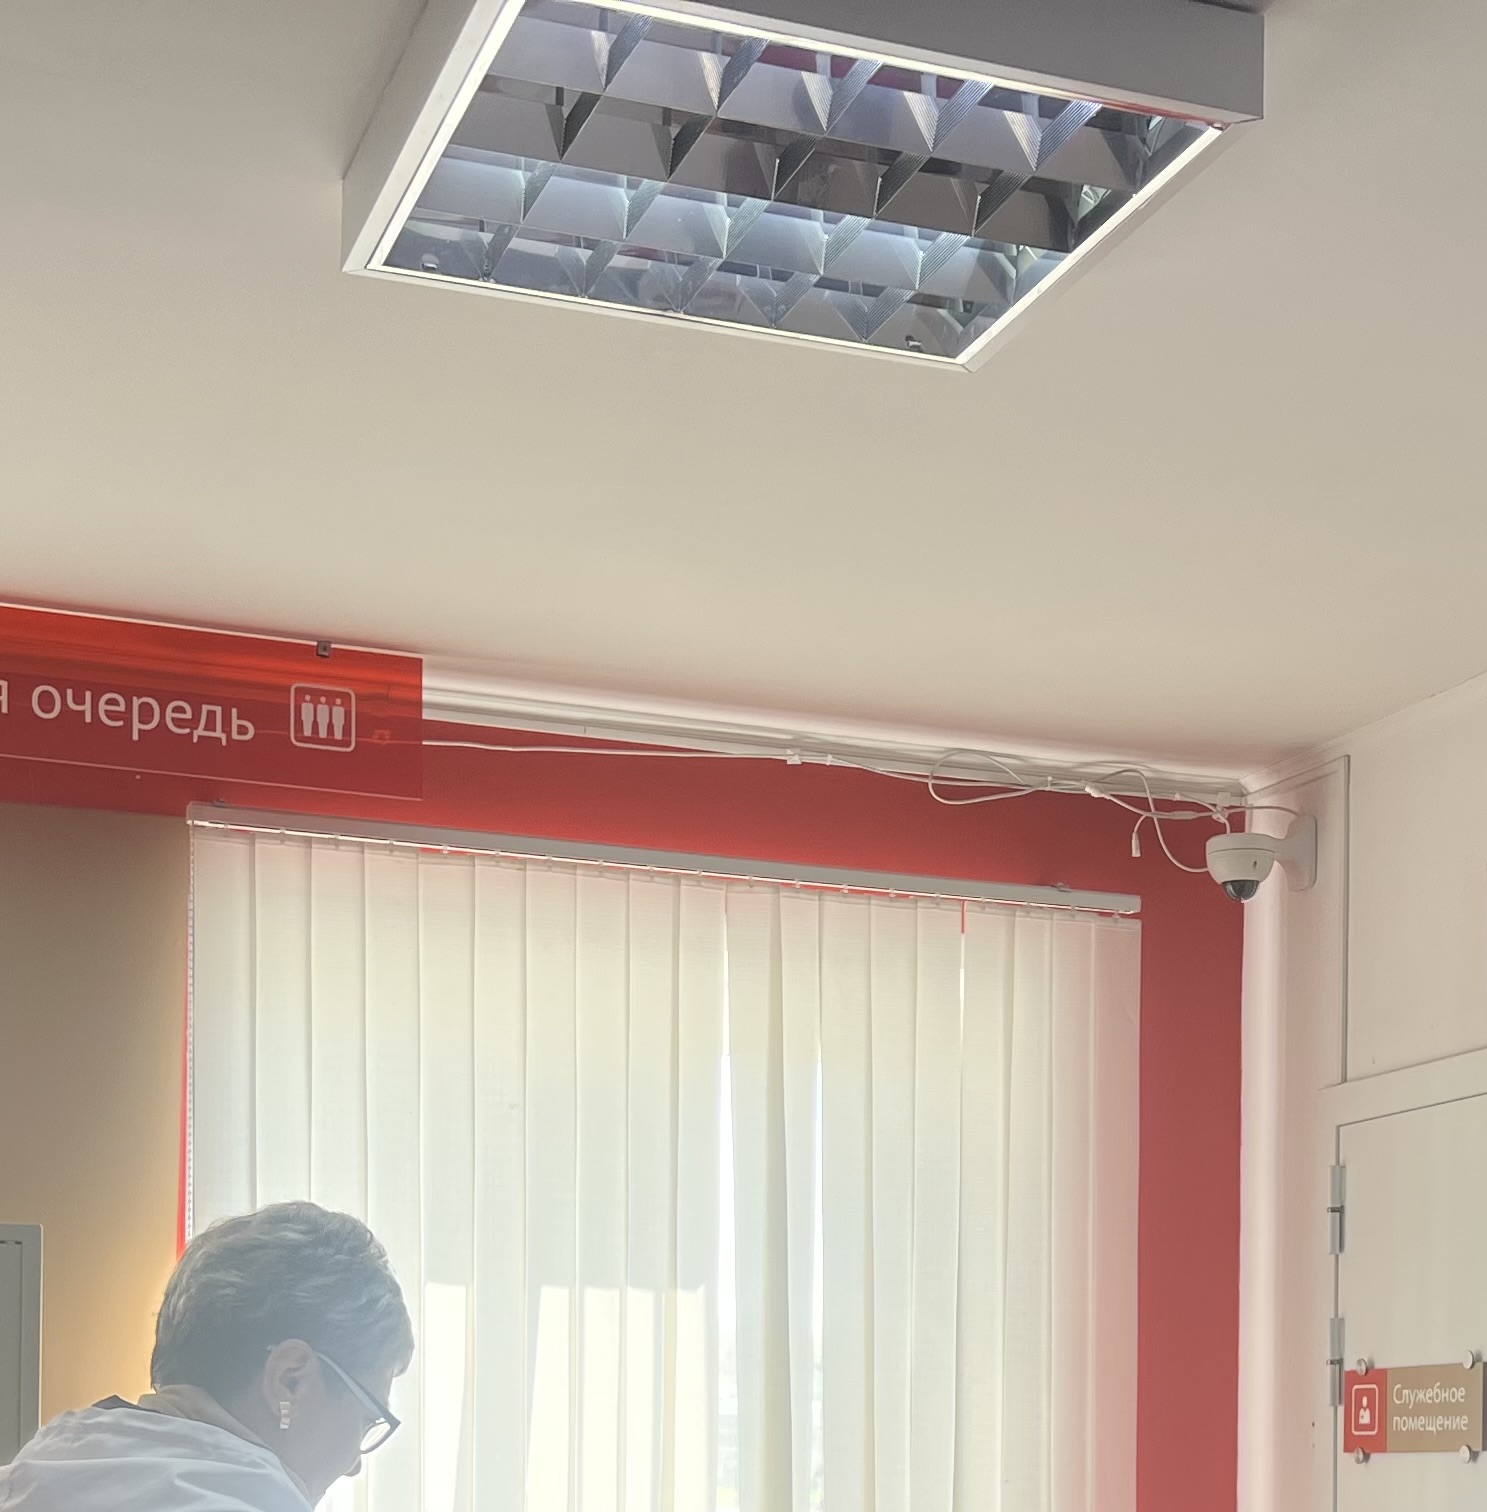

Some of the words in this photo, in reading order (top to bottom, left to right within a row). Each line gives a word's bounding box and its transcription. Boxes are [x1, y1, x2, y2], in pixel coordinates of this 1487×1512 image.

[31, 684, 256, 746] очередь
[1393, 1382, 1466, 1409] Служебное
[1393, 1414, 1469, 1435] помещение
